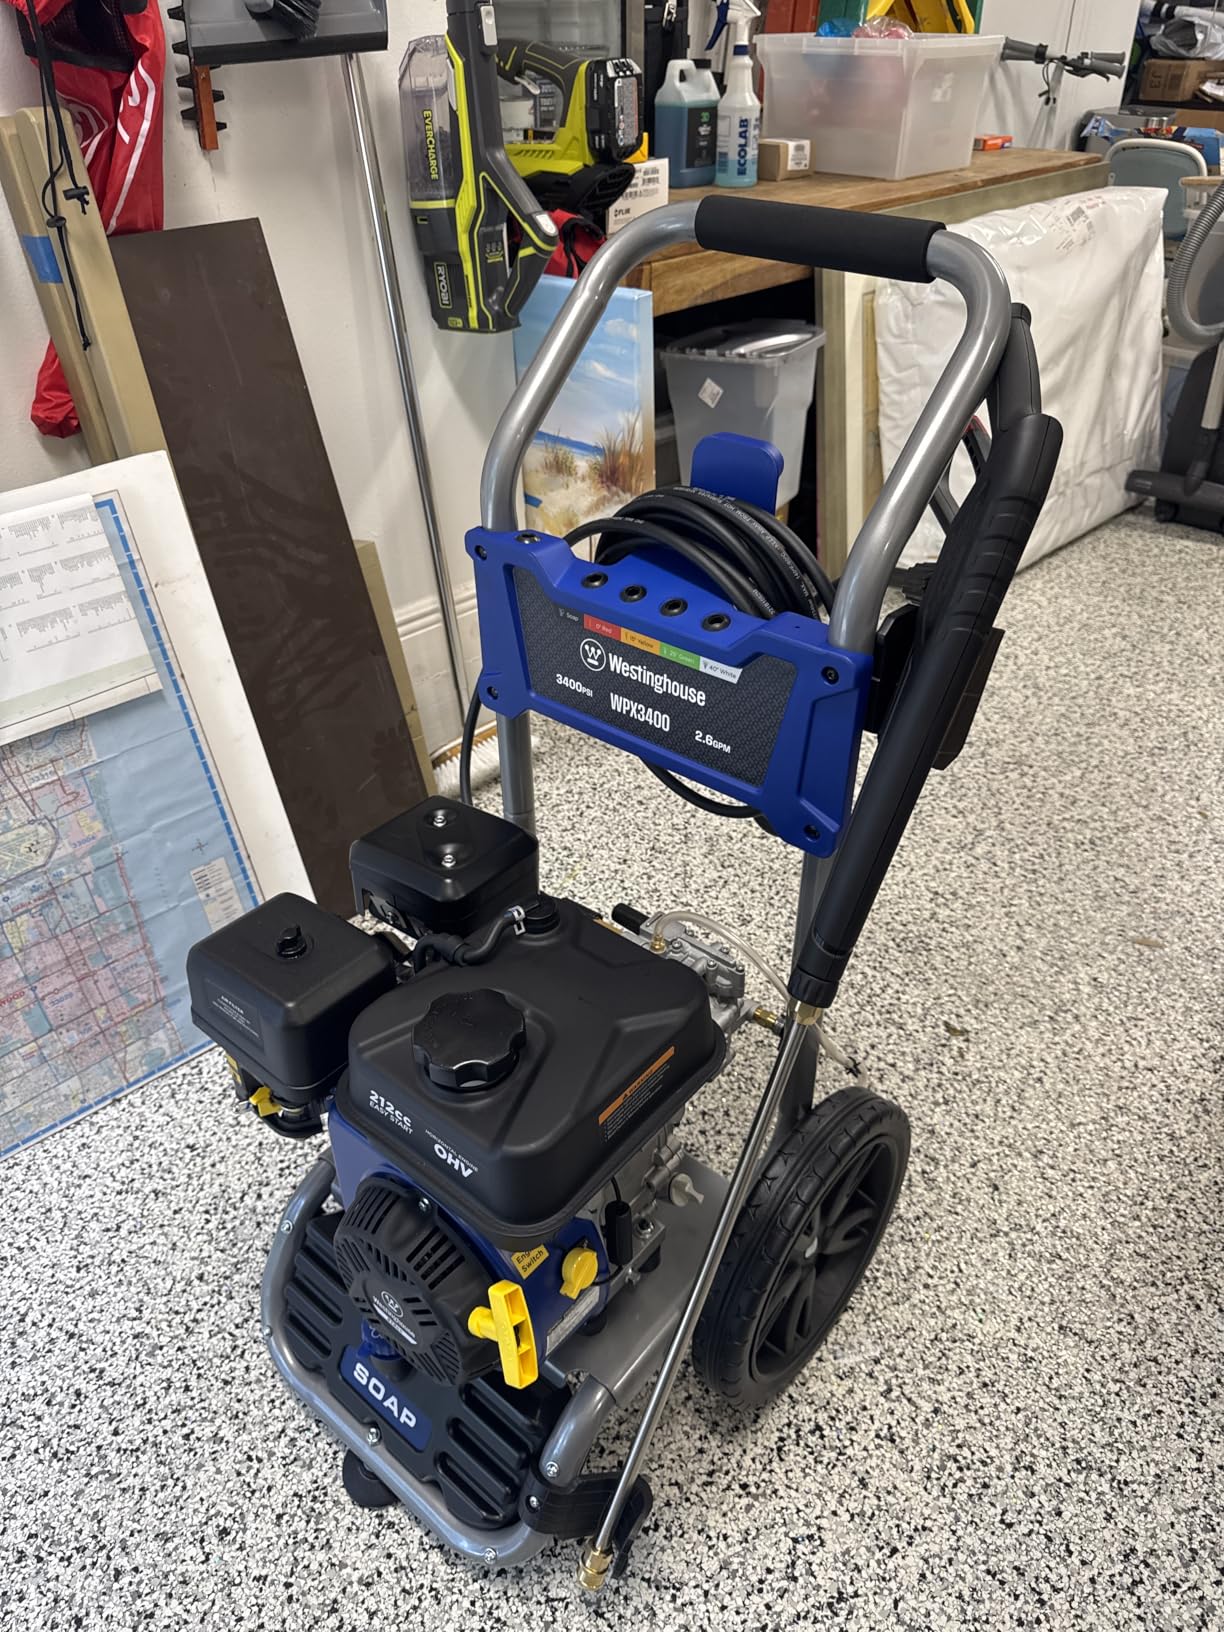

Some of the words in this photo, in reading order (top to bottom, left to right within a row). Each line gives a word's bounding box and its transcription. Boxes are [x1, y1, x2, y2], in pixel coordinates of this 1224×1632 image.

[423, 110, 439, 180] EVERCHARGE
[737, 118, 749, 176] ECOLAB
[436, 266, 449, 305] RYOBI
[556, 673, 593, 697] 3400PSI
[608, 653, 706, 707] Westinghouse
[719, 667, 737, 679] White
[610, 692, 670, 732] WPX3400
[694, 730, 731, 753] 2.6GPM
[369, 1089, 412, 1127] 212cc
[369, 1100, 389, 1117] EASY
[389, 1115, 414, 1135] START
[433, 1143, 473, 1178] OHV
[521, 1250, 544, 1273] Switch
[353, 1362, 417, 1428] SOAP
